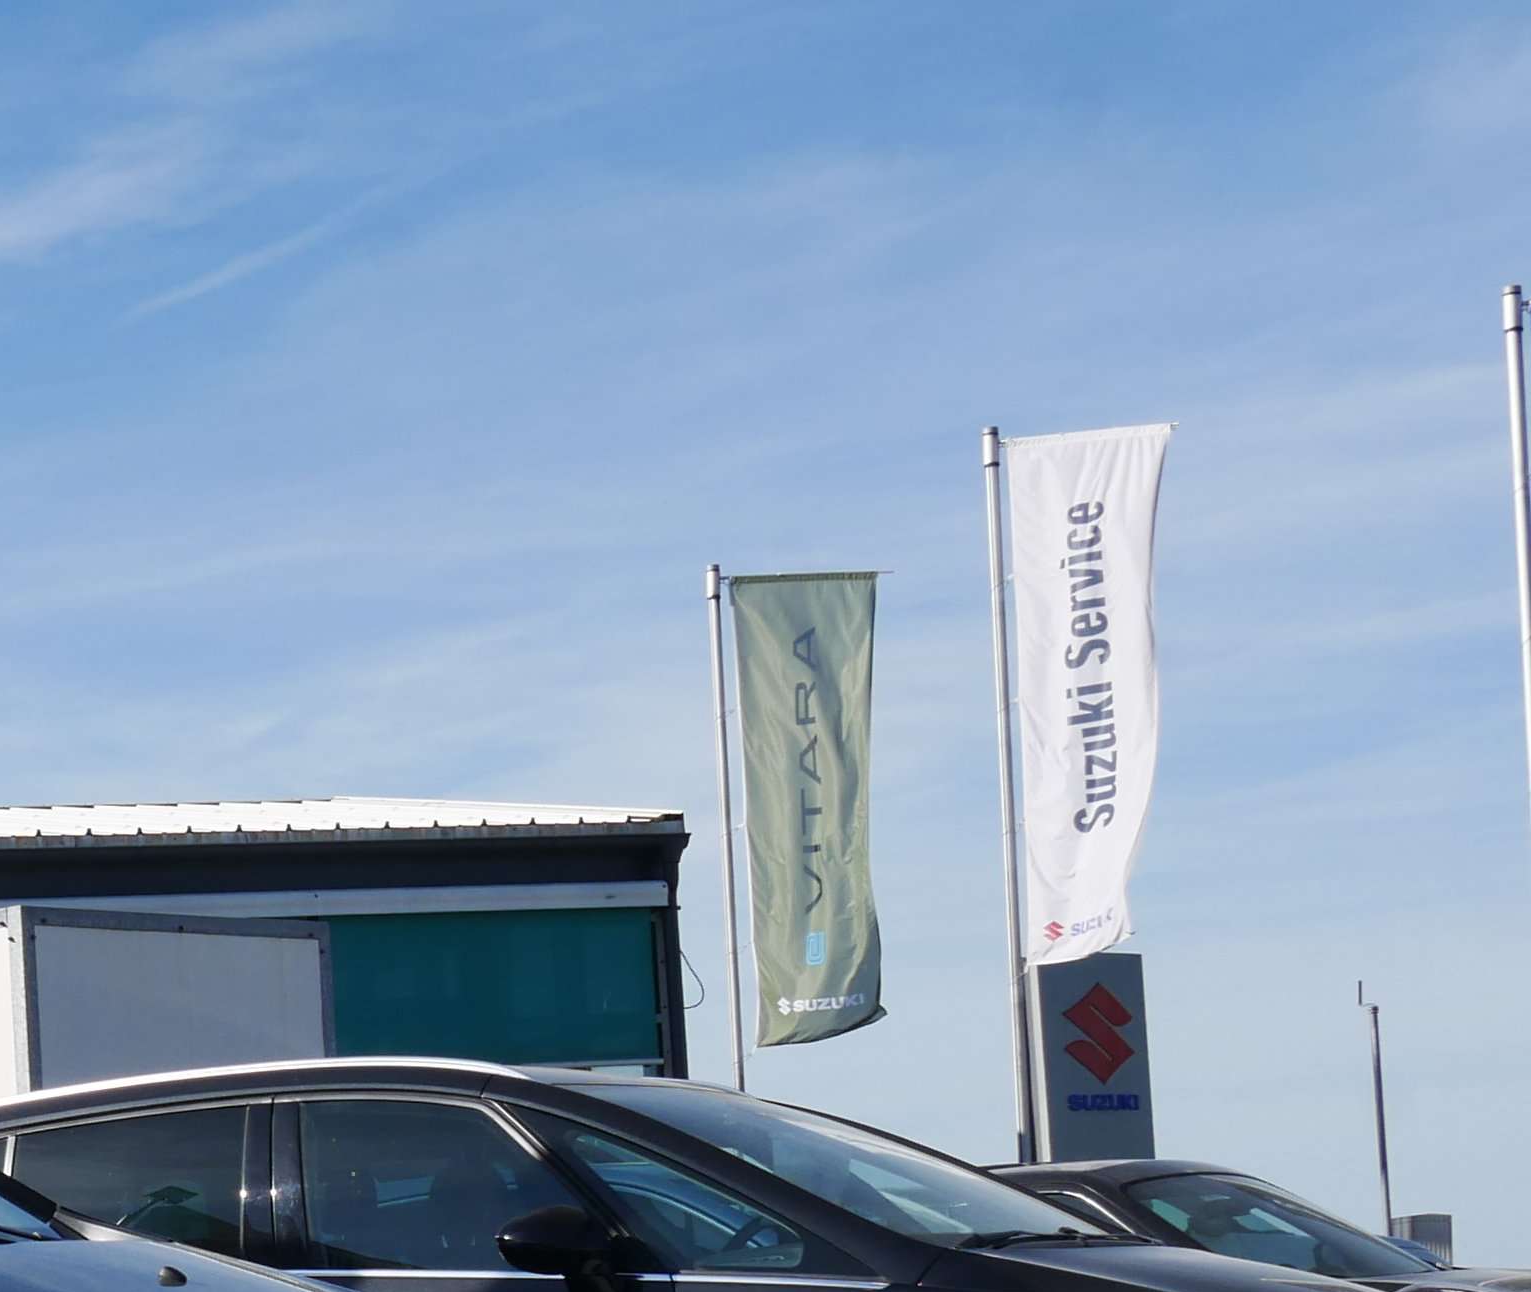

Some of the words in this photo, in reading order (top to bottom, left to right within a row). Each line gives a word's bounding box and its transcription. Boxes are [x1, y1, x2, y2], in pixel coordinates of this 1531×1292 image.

[1060, 501, 1112, 670] Service
[793, 627, 823, 915] VITARA
[1066, 681, 1118, 833] Suzuki
[793, 993, 864, 1013] SUZUKI
[1067, 1094, 1139, 1111] SUZUKI
